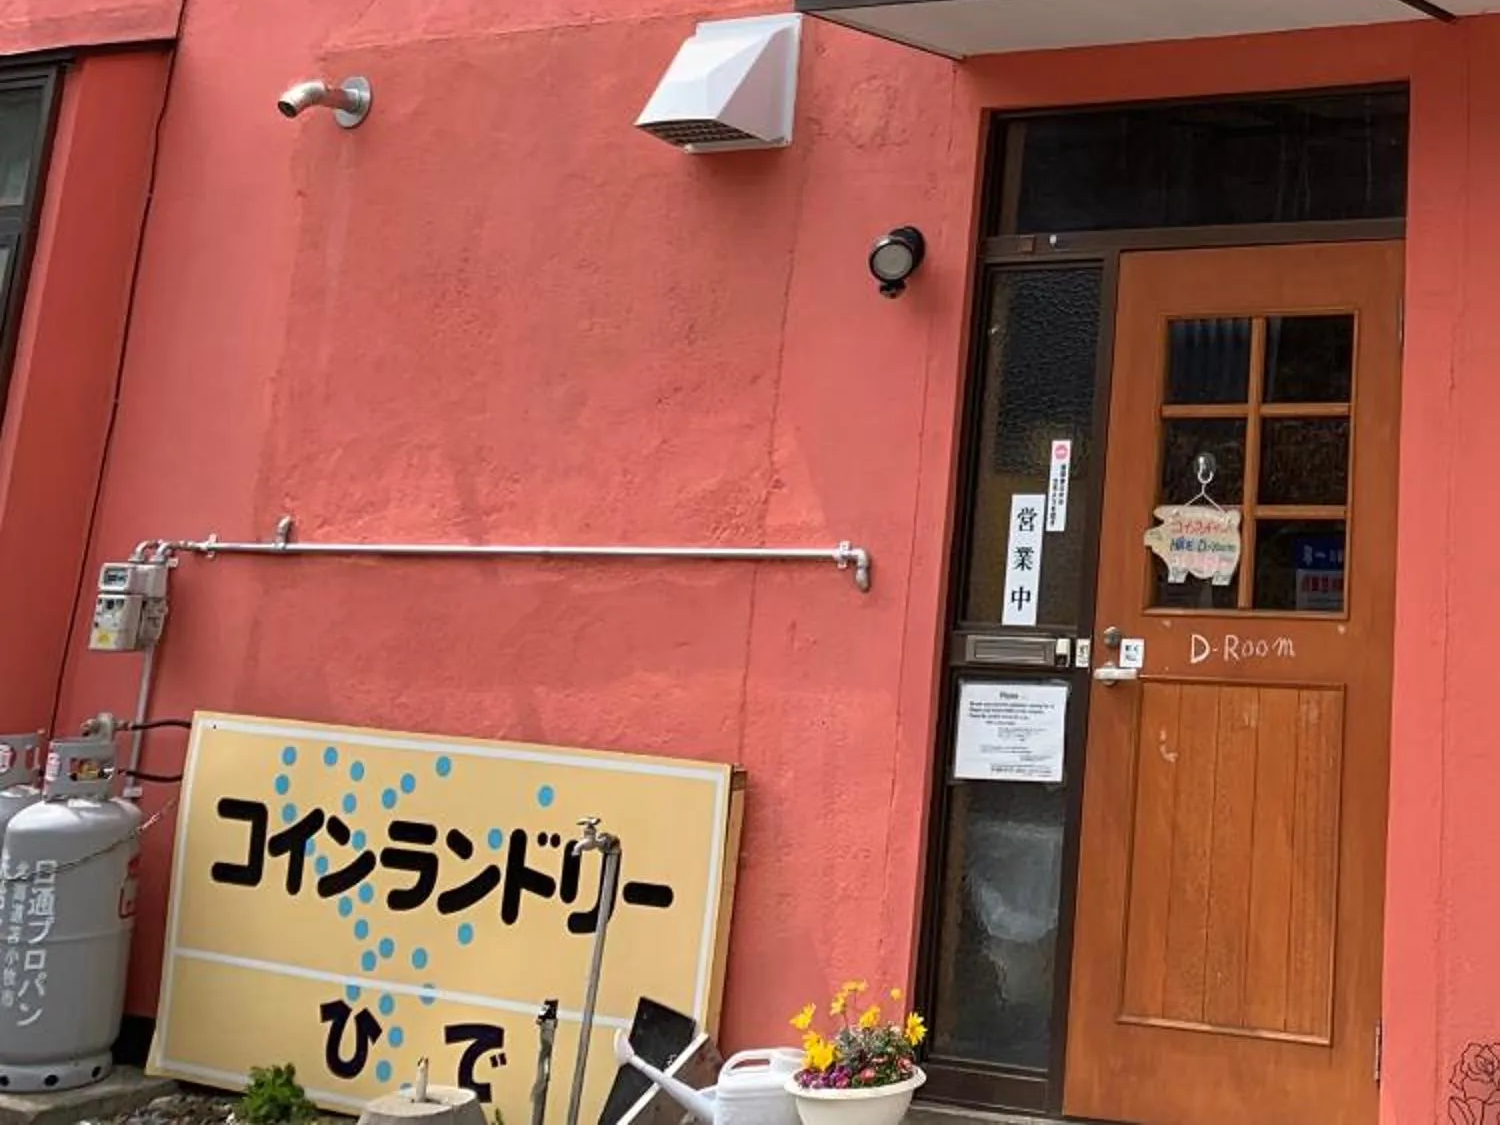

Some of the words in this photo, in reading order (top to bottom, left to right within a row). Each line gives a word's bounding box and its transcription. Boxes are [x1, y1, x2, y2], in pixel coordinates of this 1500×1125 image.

[1011, 506, 1038, 612] 営業中
[211, 797, 674, 935] コインランドリー
